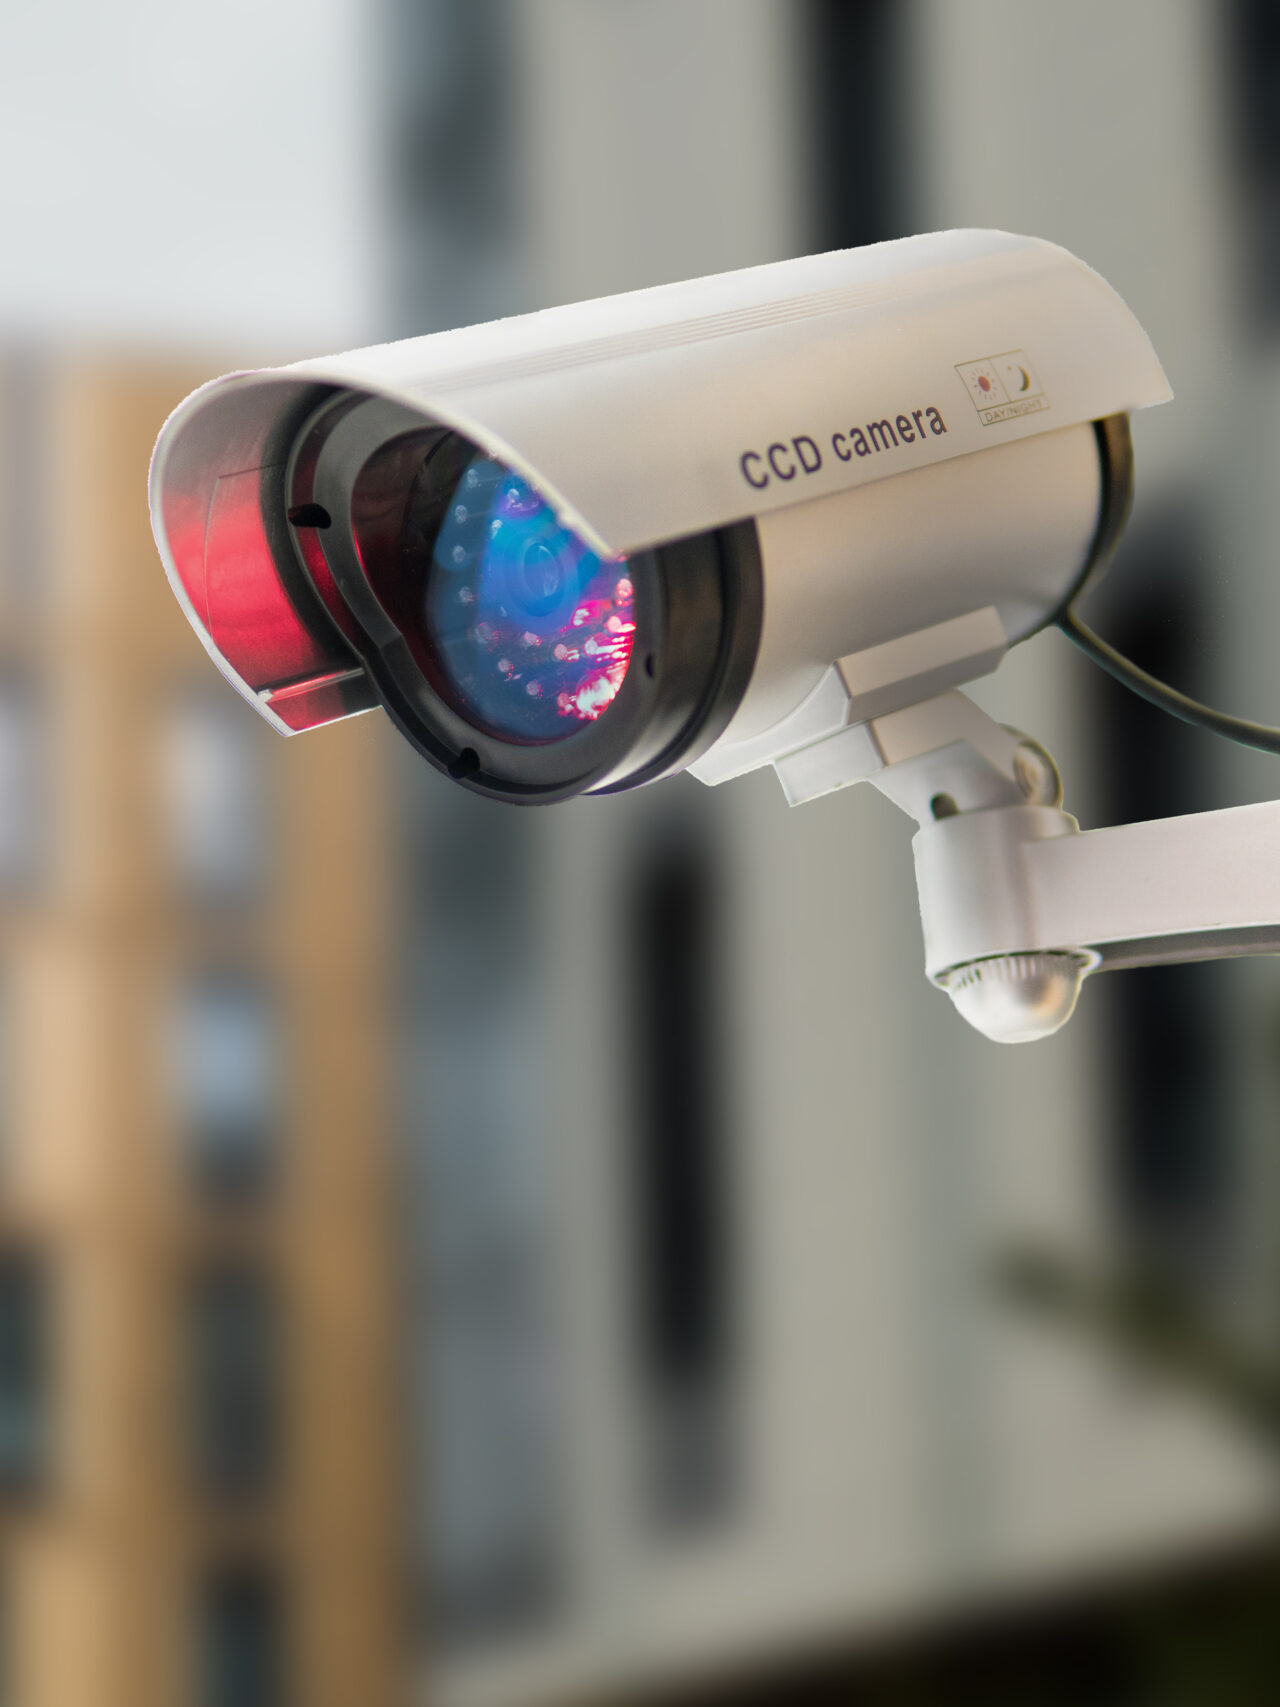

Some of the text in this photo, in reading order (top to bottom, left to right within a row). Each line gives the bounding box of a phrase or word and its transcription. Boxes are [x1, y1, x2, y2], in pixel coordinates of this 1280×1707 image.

[984, 399, 1043, 422] DAY/NIGHT
[740, 406, 948, 490] CCD camera
